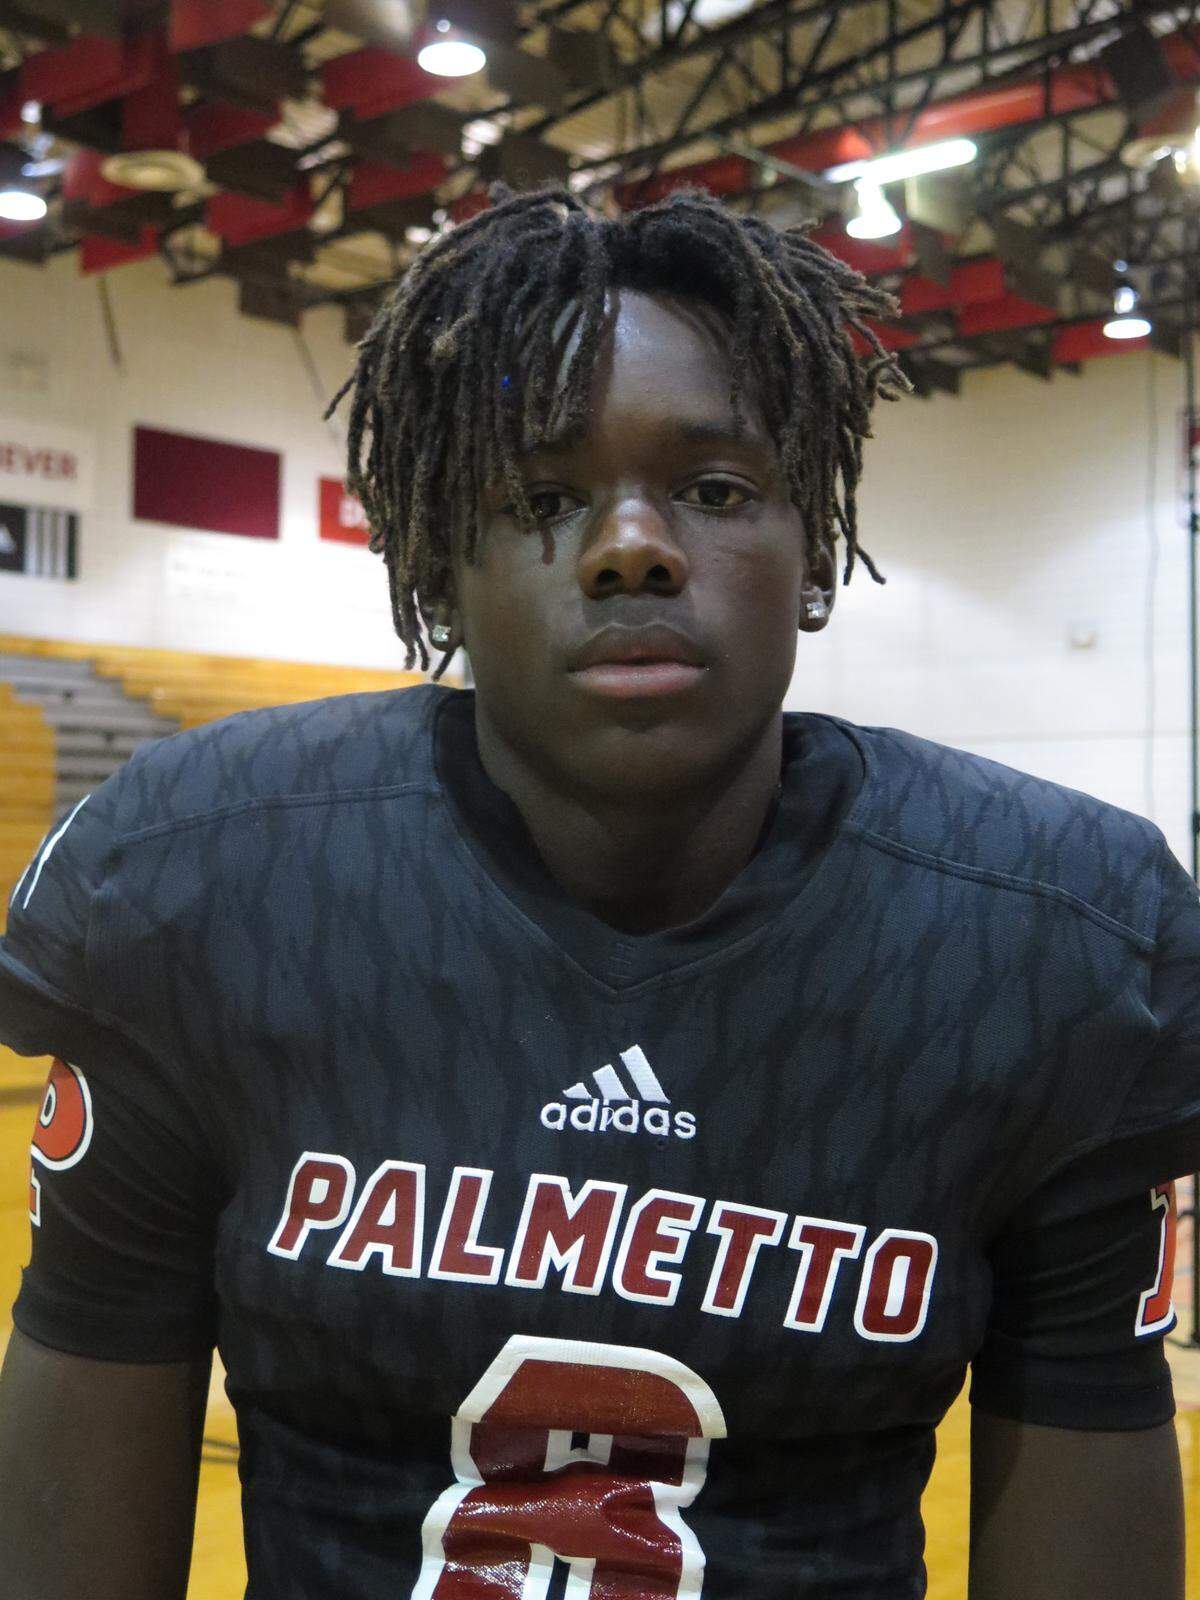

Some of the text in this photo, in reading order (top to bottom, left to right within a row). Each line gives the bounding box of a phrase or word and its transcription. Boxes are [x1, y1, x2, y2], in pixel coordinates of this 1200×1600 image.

[0, 443, 77, 480] EVER
[540, 1098, 697, 1140] adidas
[267, 1151, 939, 1343] PALMETTO
[410, 1334, 728, 1600] 8
